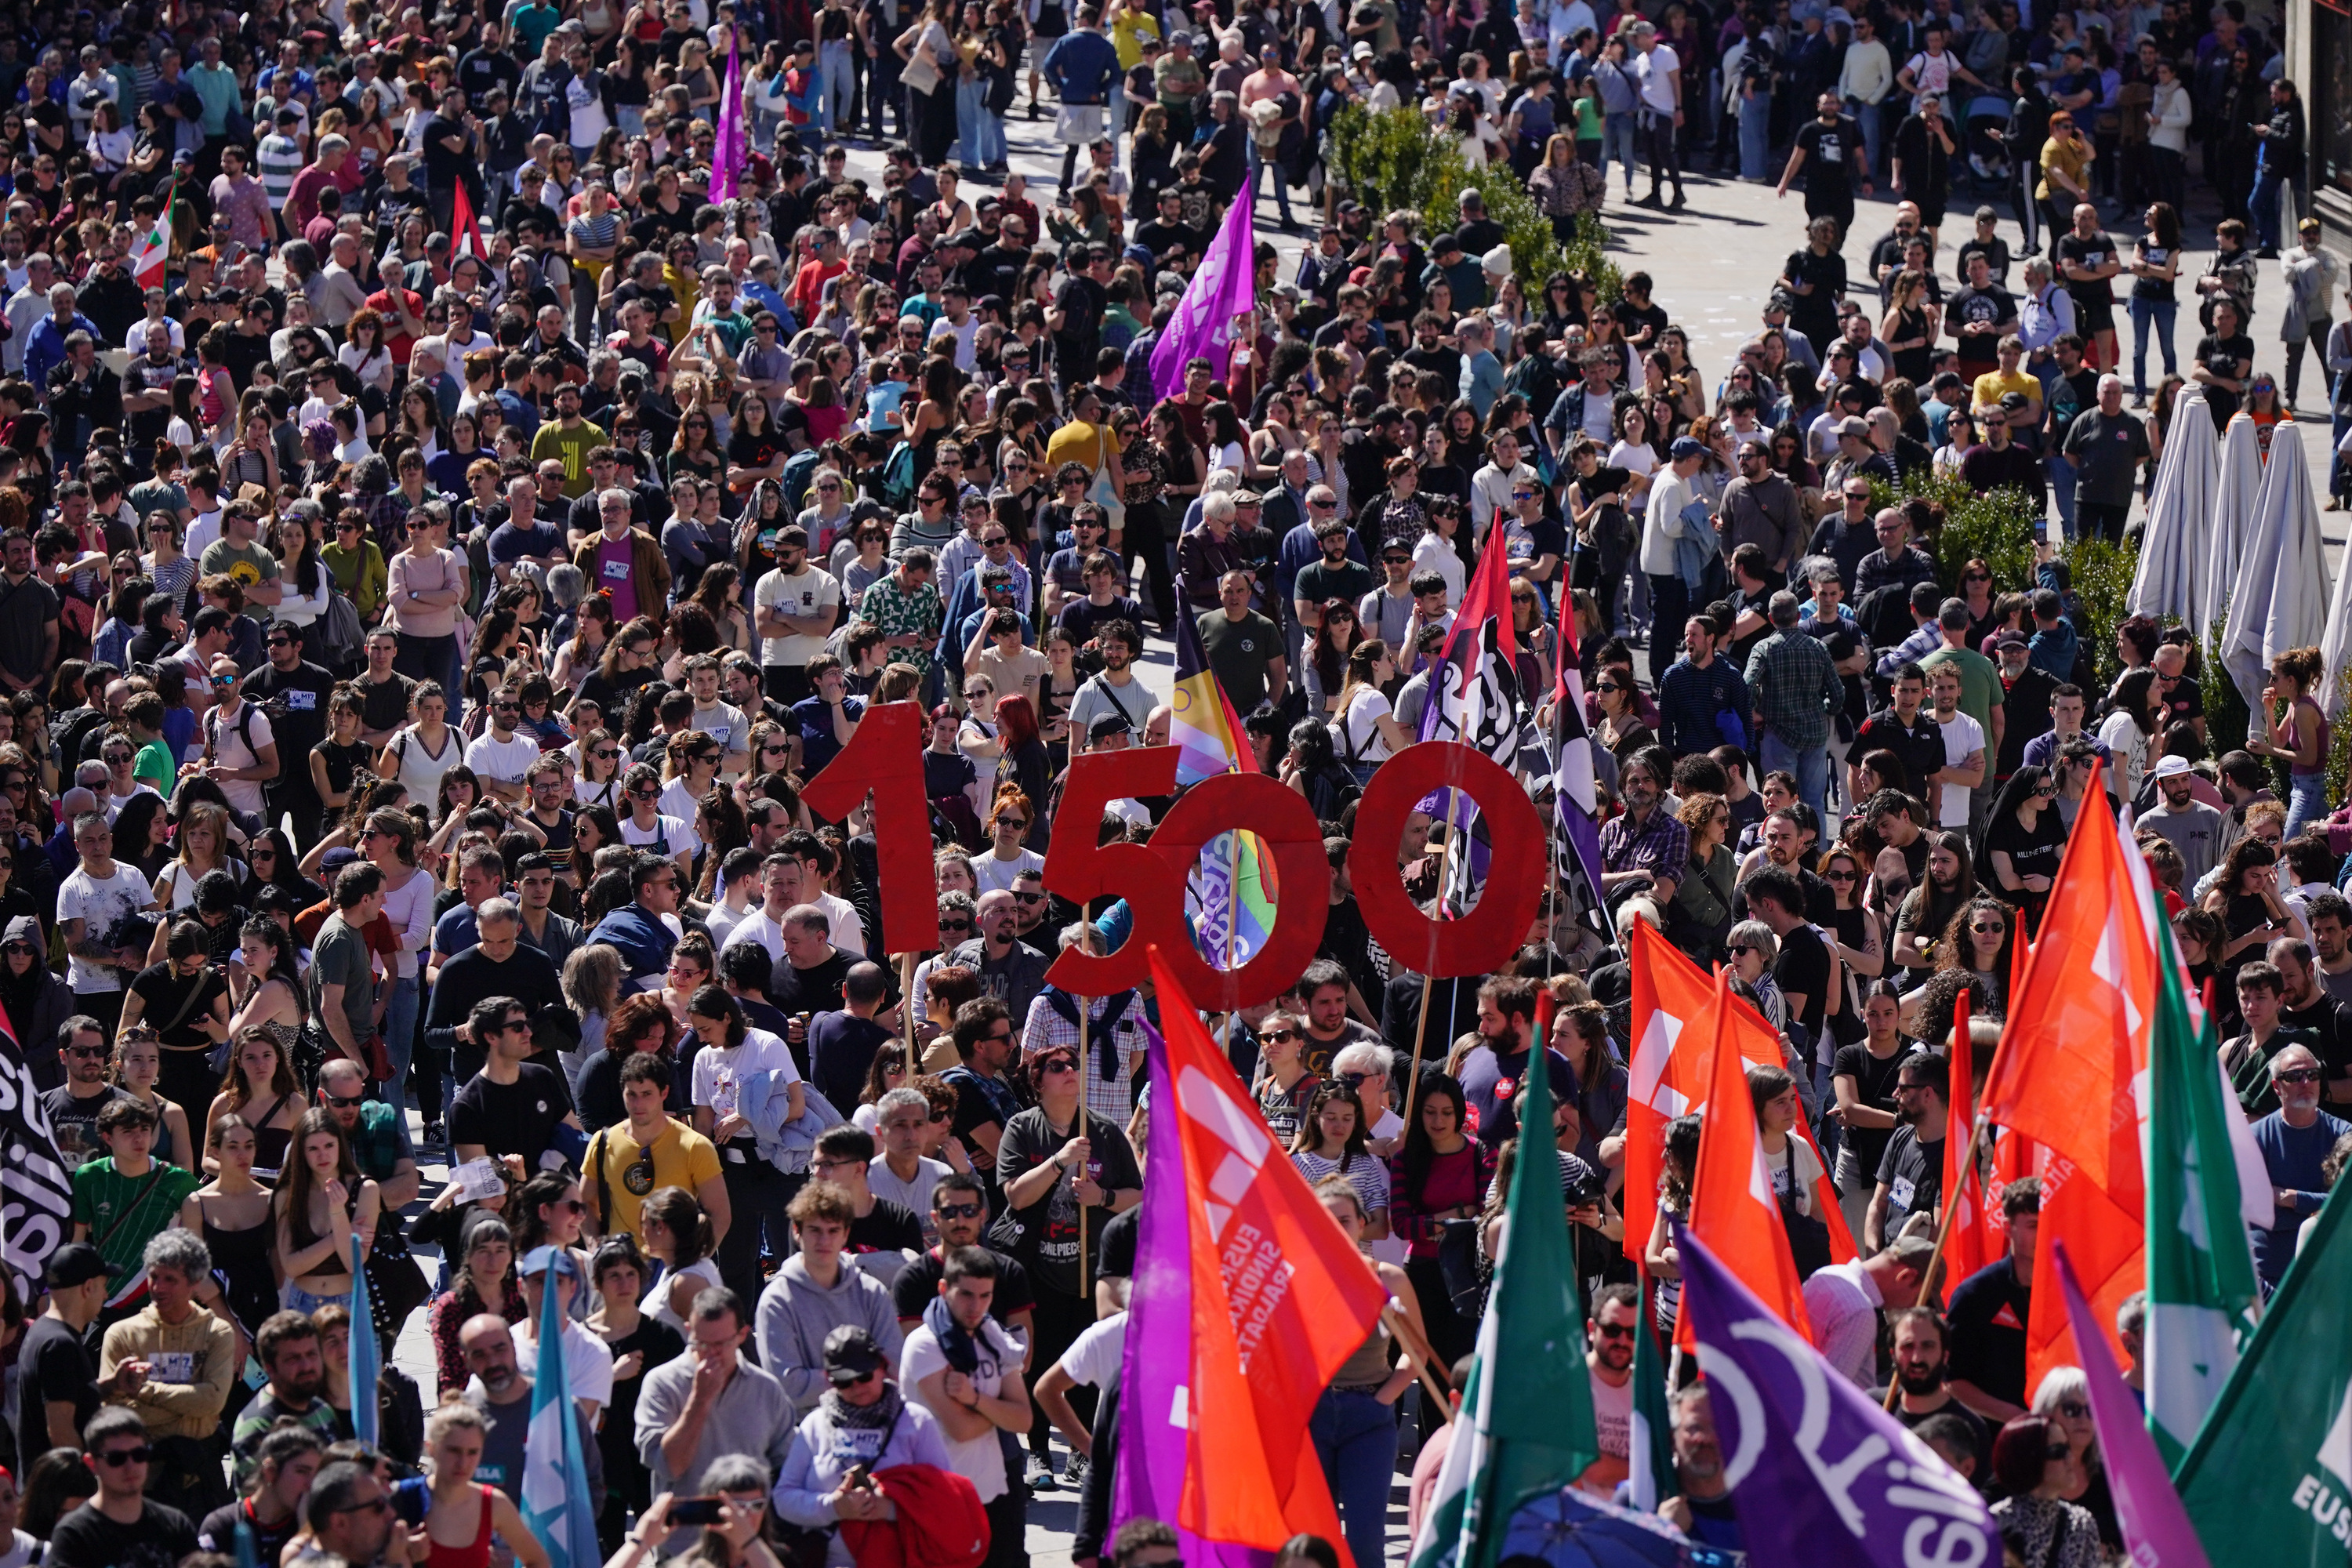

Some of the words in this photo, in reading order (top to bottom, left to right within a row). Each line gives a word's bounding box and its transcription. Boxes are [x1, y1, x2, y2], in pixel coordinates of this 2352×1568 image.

[2029, 848, 2038, 857] THE
[2039, 844, 2053, 854] TERF
[1774, 1169, 1788, 1180] M1
[1040, 1240, 1057, 1256] ONE
[1057, 1240, 1081, 1257] PIECE
[169, 1356, 190, 1367] M7
[475, 1467, 502, 1479] ELA
[2292, 1472, 2352, 1549] EUS
